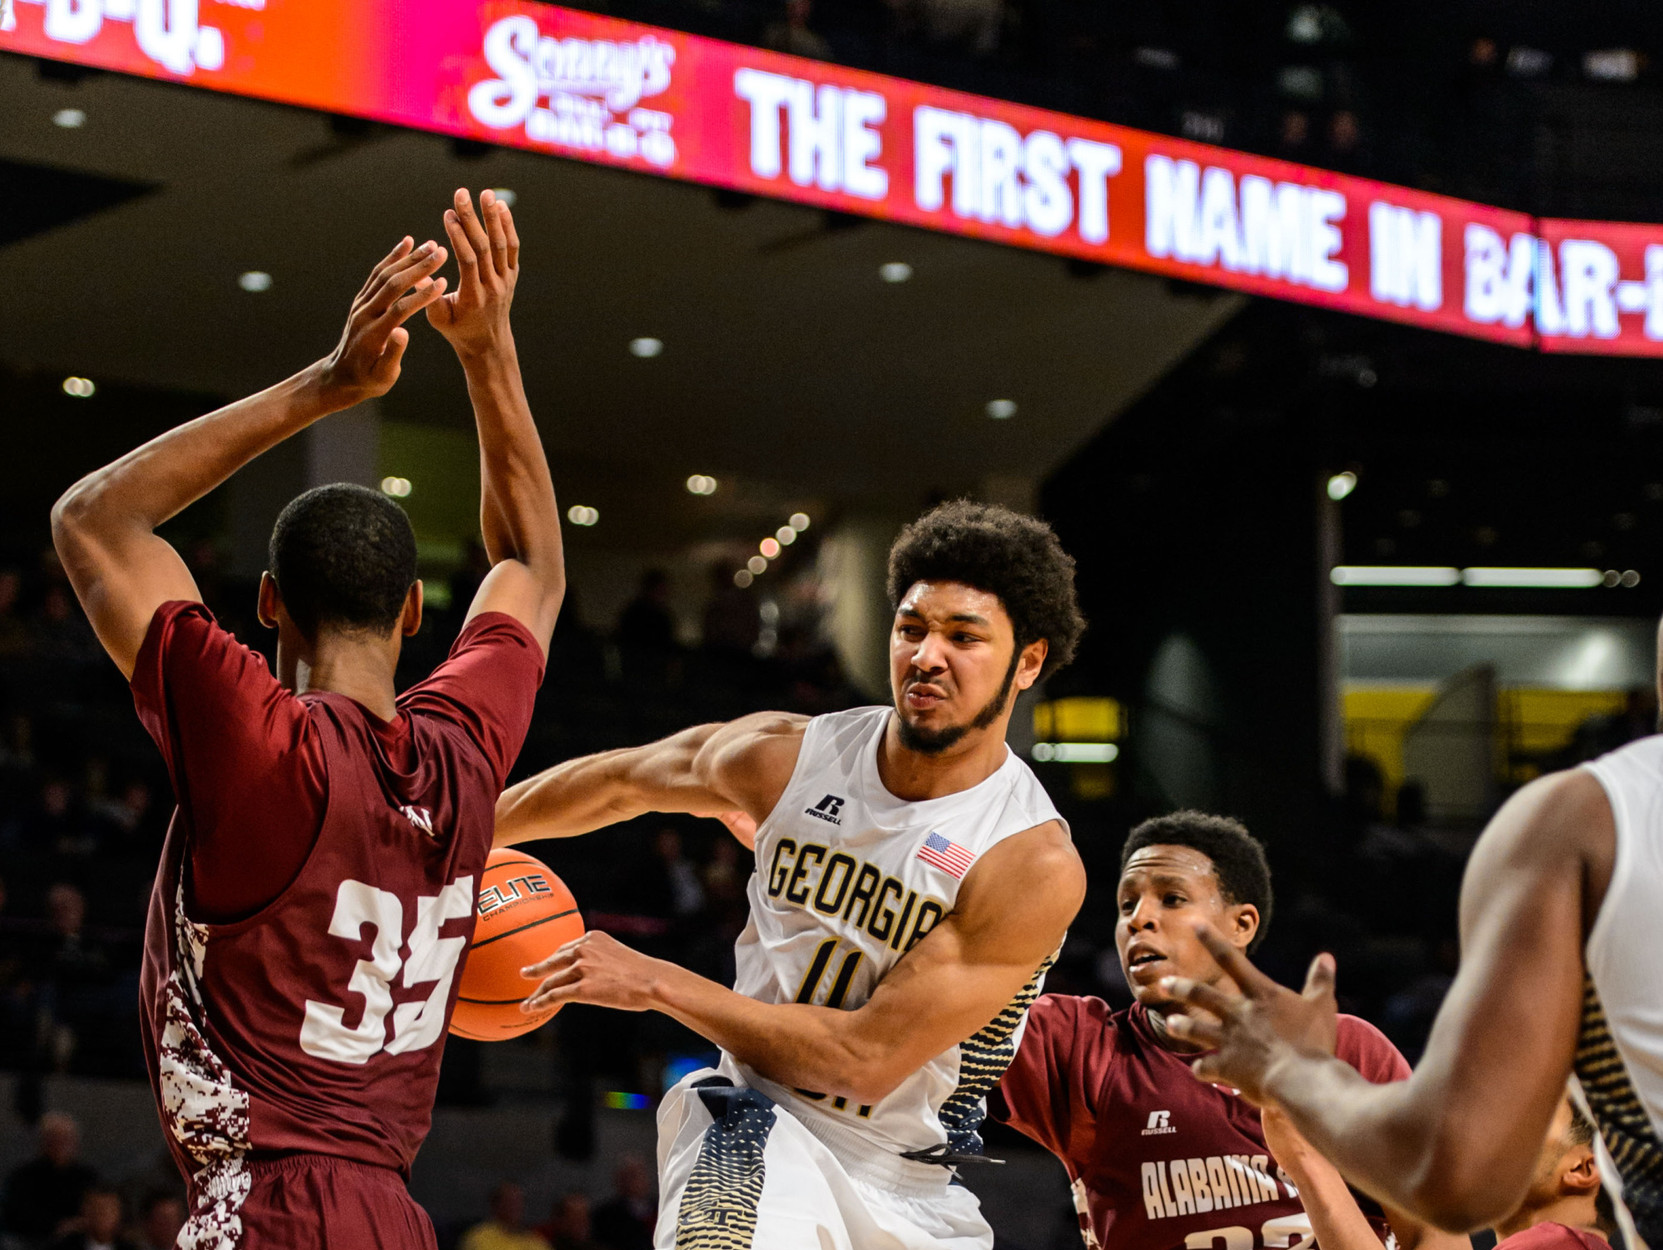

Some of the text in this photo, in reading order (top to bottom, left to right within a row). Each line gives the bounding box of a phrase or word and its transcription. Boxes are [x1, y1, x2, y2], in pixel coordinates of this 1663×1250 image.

[734, 67, 888, 201] THE
[913, 105, 1122, 245] FIRST
[1145, 154, 1349, 292] NAME
[1369, 201, 1442, 310] IN
[1464, 222, 1663, 338] BAR-
[804, 807, 842, 826] RUSSELL
[768, 837, 944, 953] GEORGIA
[300, 875, 473, 1065] 35
[1141, 1126, 1177, 1136] RUSSELL
[1141, 1154, 1279, 1220] ALABAMA
